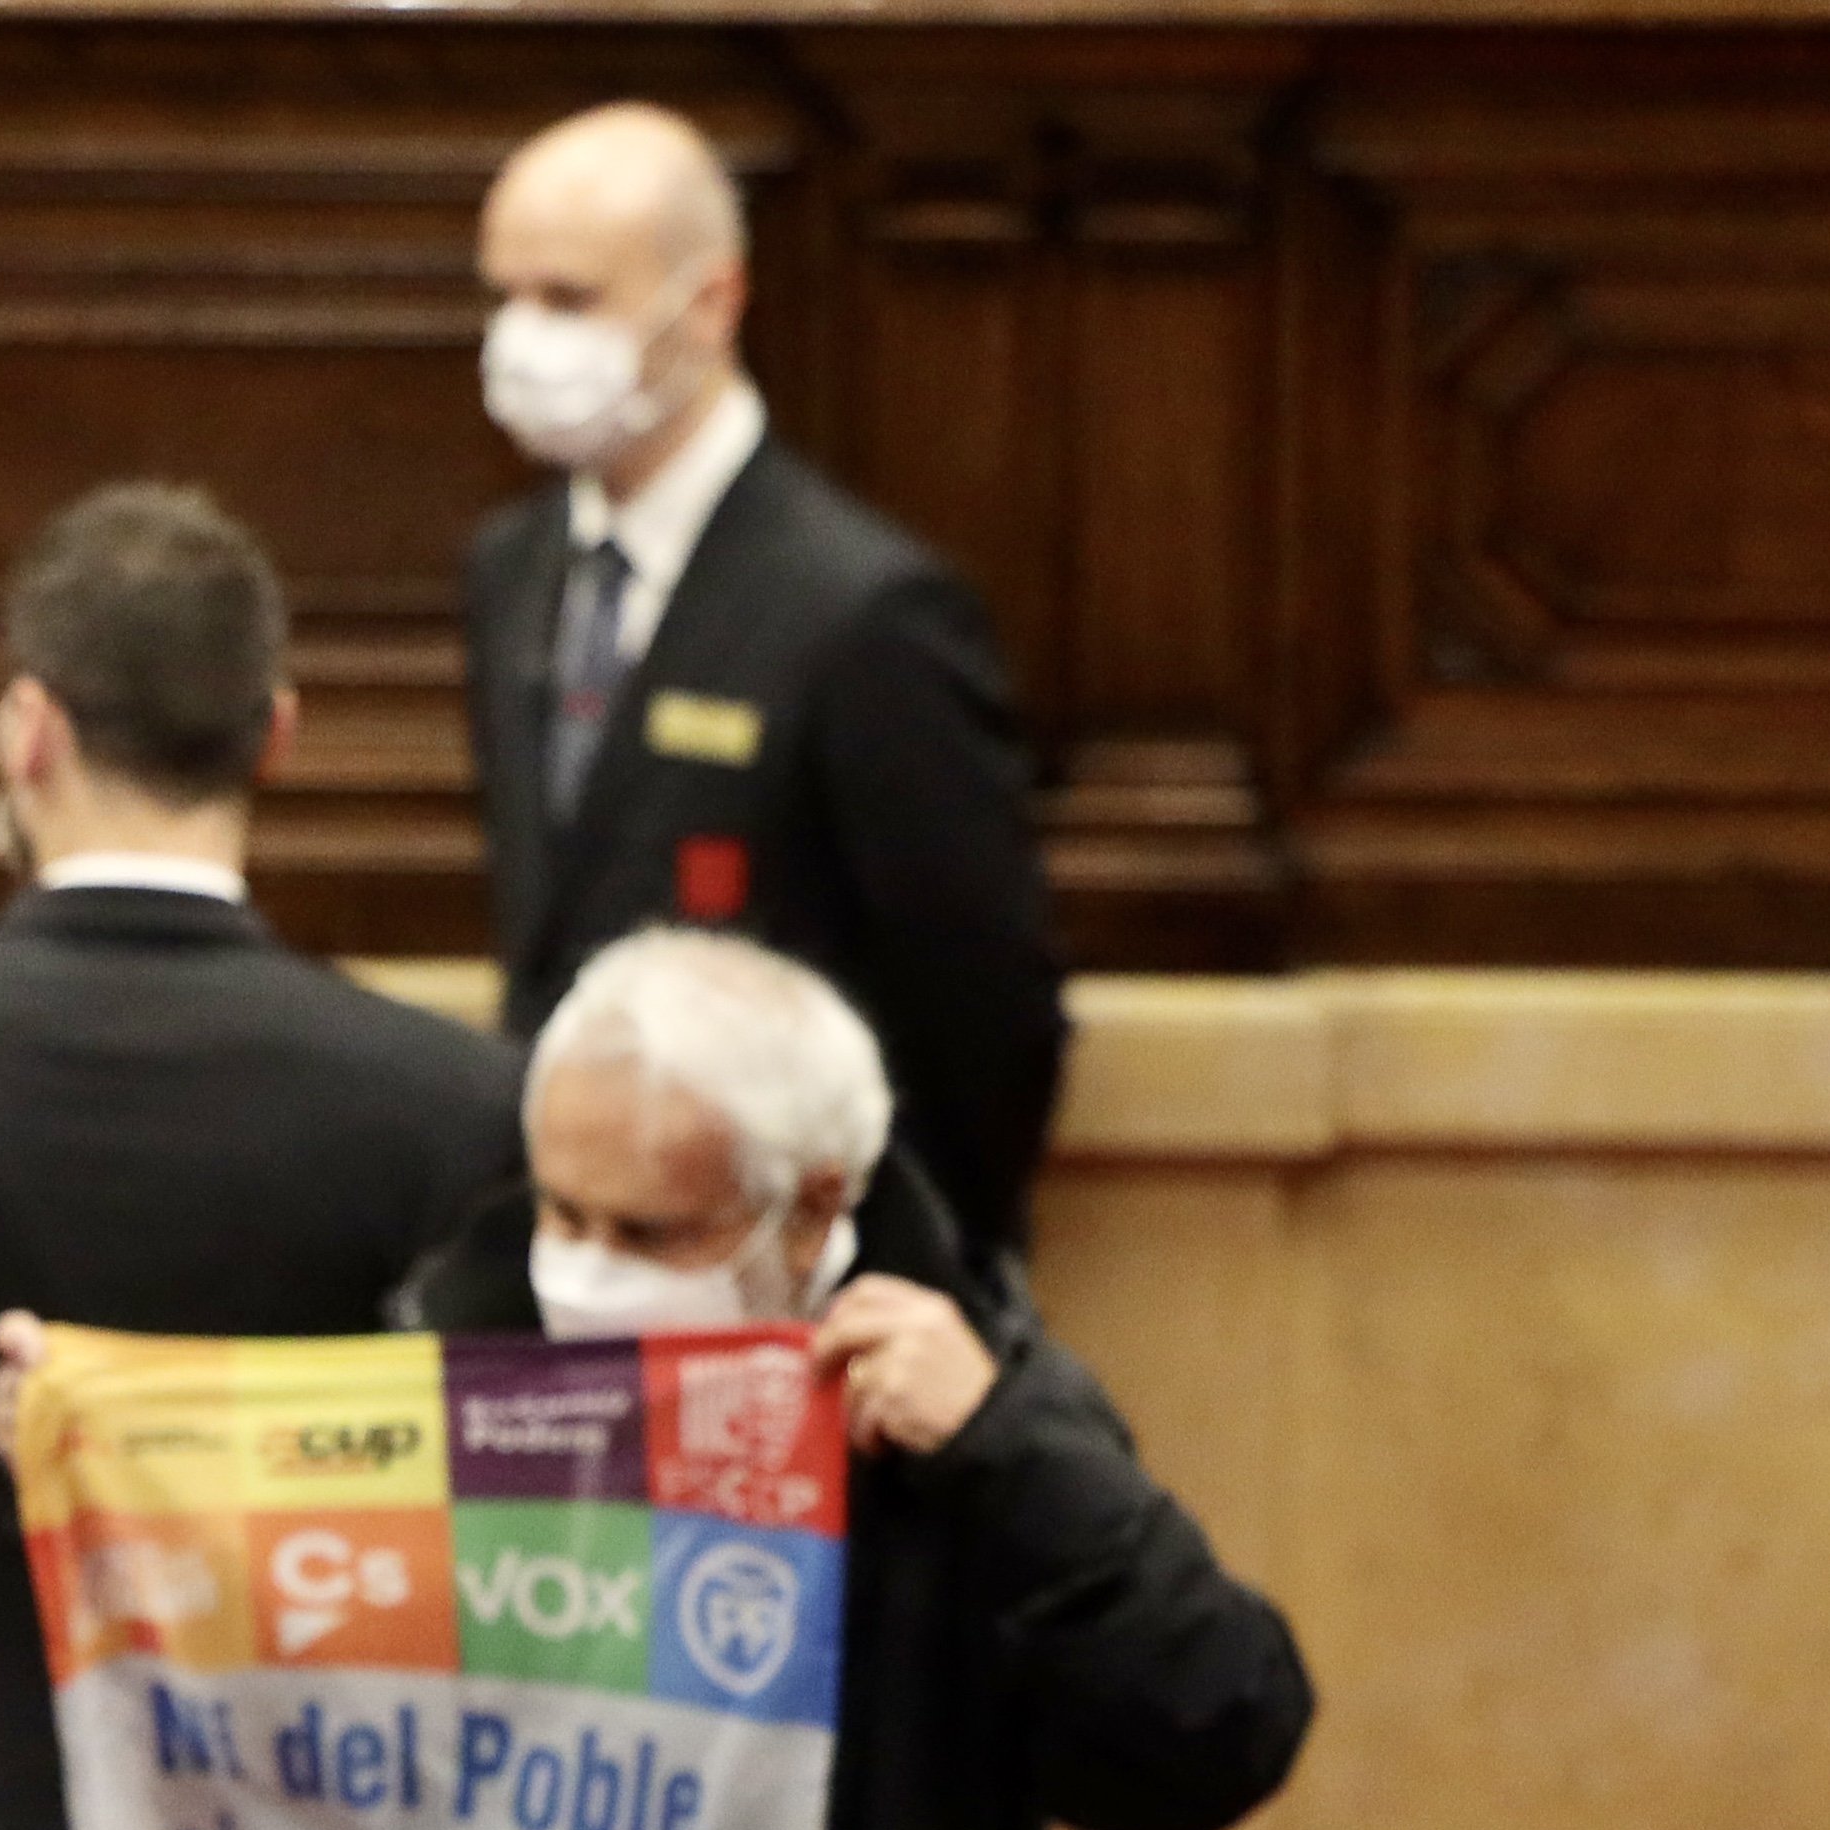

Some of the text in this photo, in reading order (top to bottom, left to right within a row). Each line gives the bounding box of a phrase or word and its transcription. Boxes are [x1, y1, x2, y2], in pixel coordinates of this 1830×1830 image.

[272, 1528, 411, 1608] Cs
[455, 1544, 640, 1642] VOX
[149, 1682, 240, 1778] Ni
[274, 1699, 420, 1810] del
